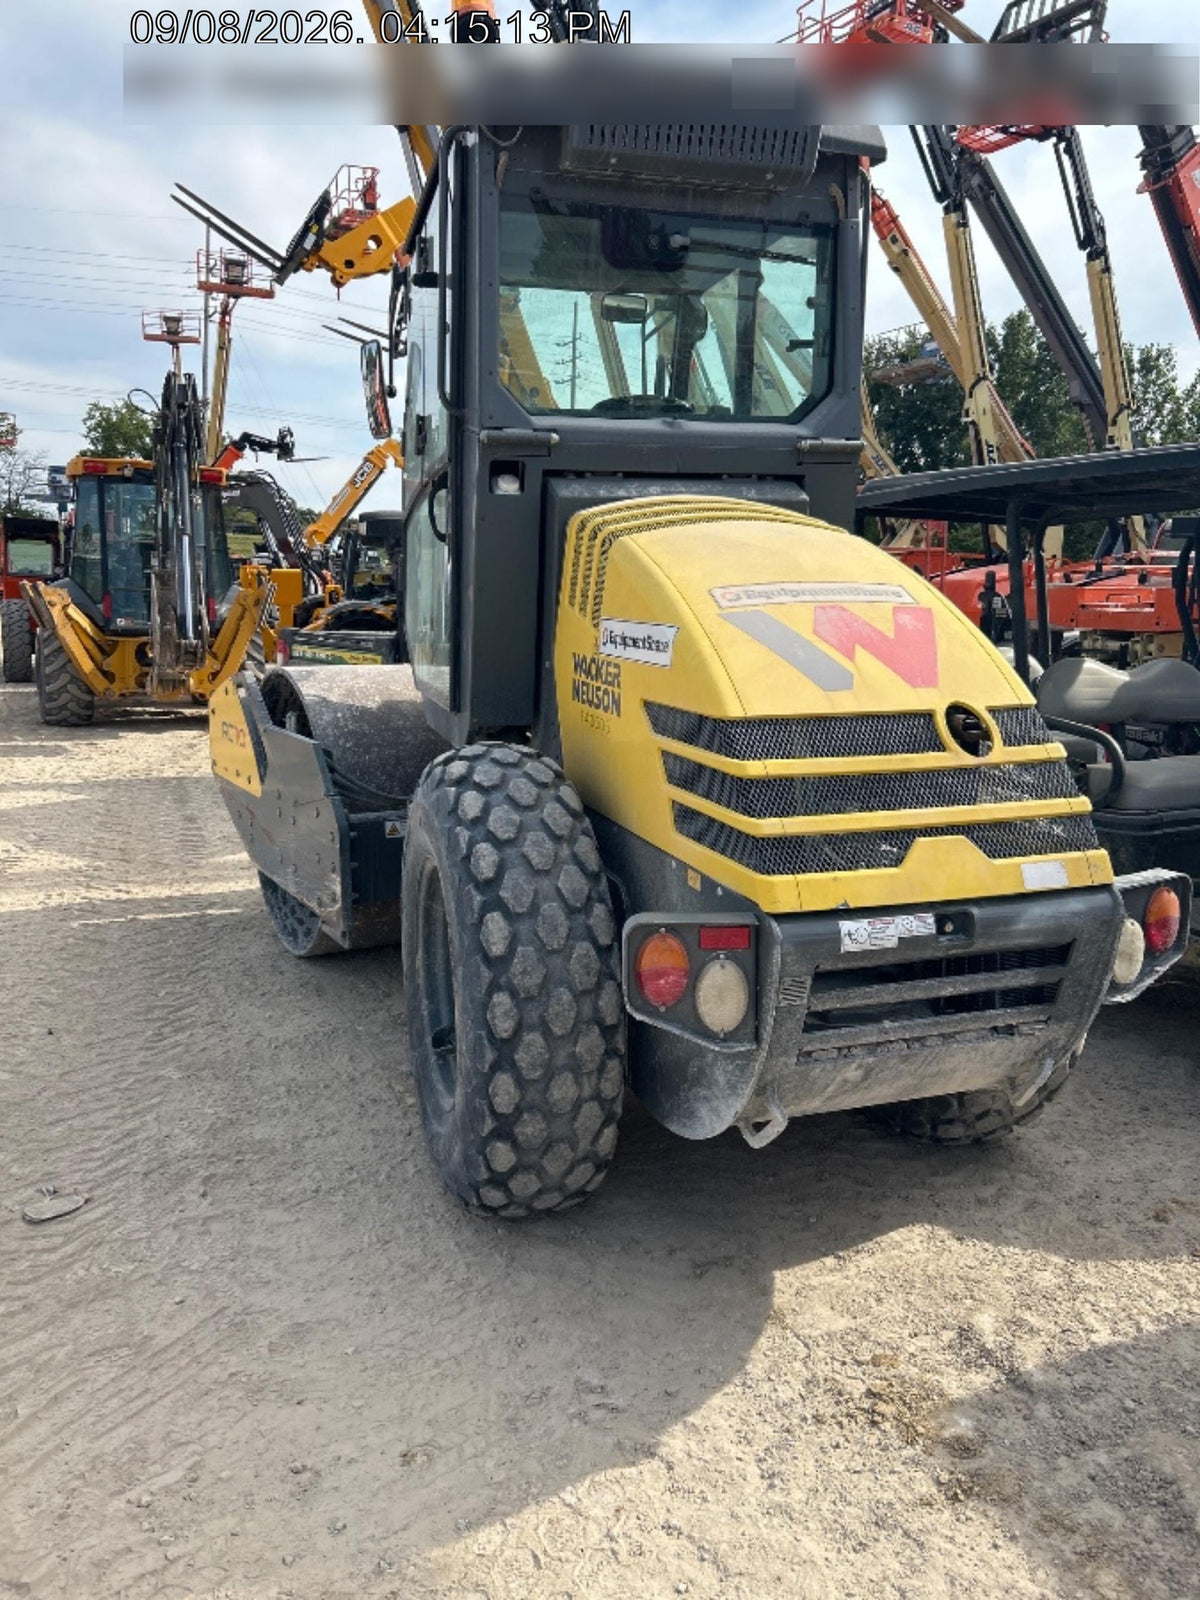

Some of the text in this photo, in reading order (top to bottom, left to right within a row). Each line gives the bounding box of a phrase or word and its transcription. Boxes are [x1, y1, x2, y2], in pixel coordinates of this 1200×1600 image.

[353, 461, 375, 488] JCB
[572, 652, 621, 691] WACKER
[572, 678, 621, 718] NEUSON
